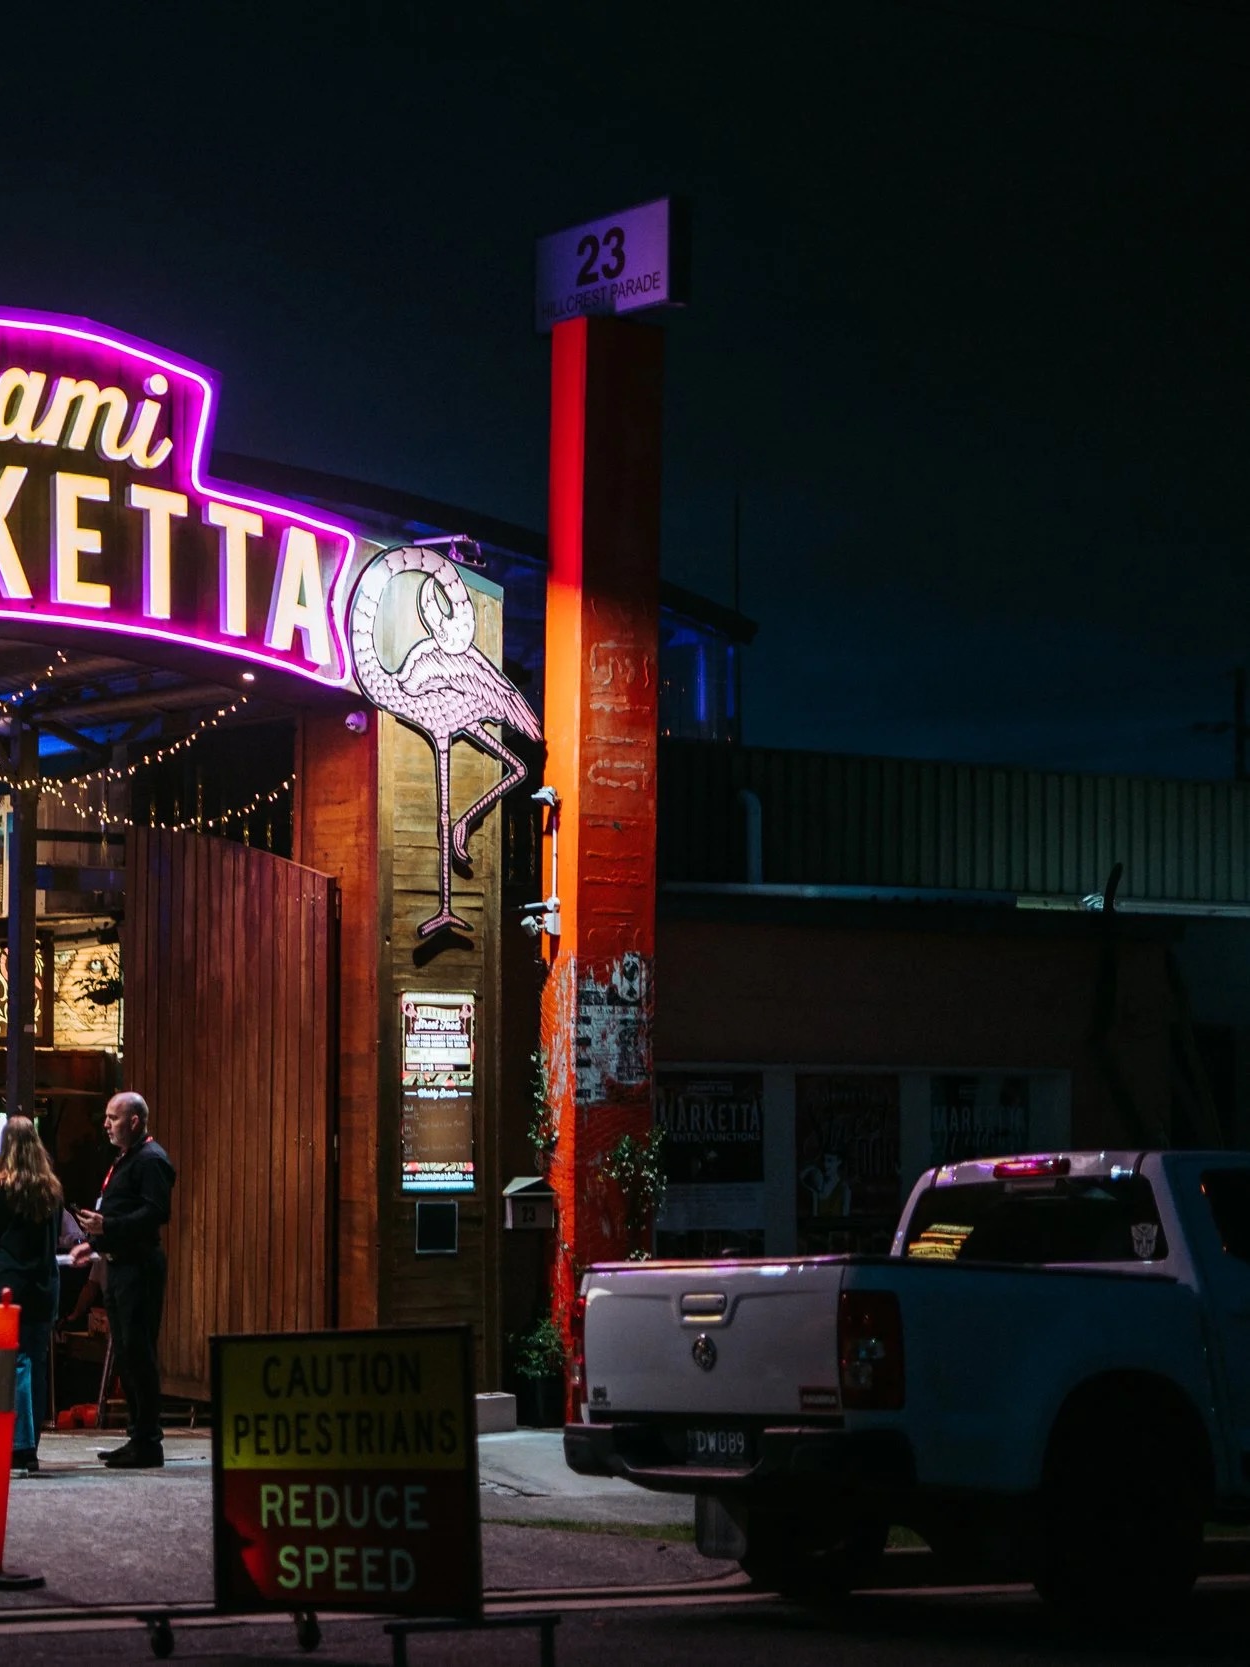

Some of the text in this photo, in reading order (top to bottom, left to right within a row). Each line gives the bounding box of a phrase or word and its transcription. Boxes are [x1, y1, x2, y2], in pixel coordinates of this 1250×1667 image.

[576, 226, 626, 287] 23
[542, 271, 661, 320] HILLCREST PARADE
[655, 1093, 761, 1133] MARKETTA
[263, 1352, 421, 1399] CAUTION
[234, 1408, 458, 1456] PEDESTRIANS
[259, 1484, 431, 1530] REDUCE
[276, 1544, 418, 1592] SPEED
